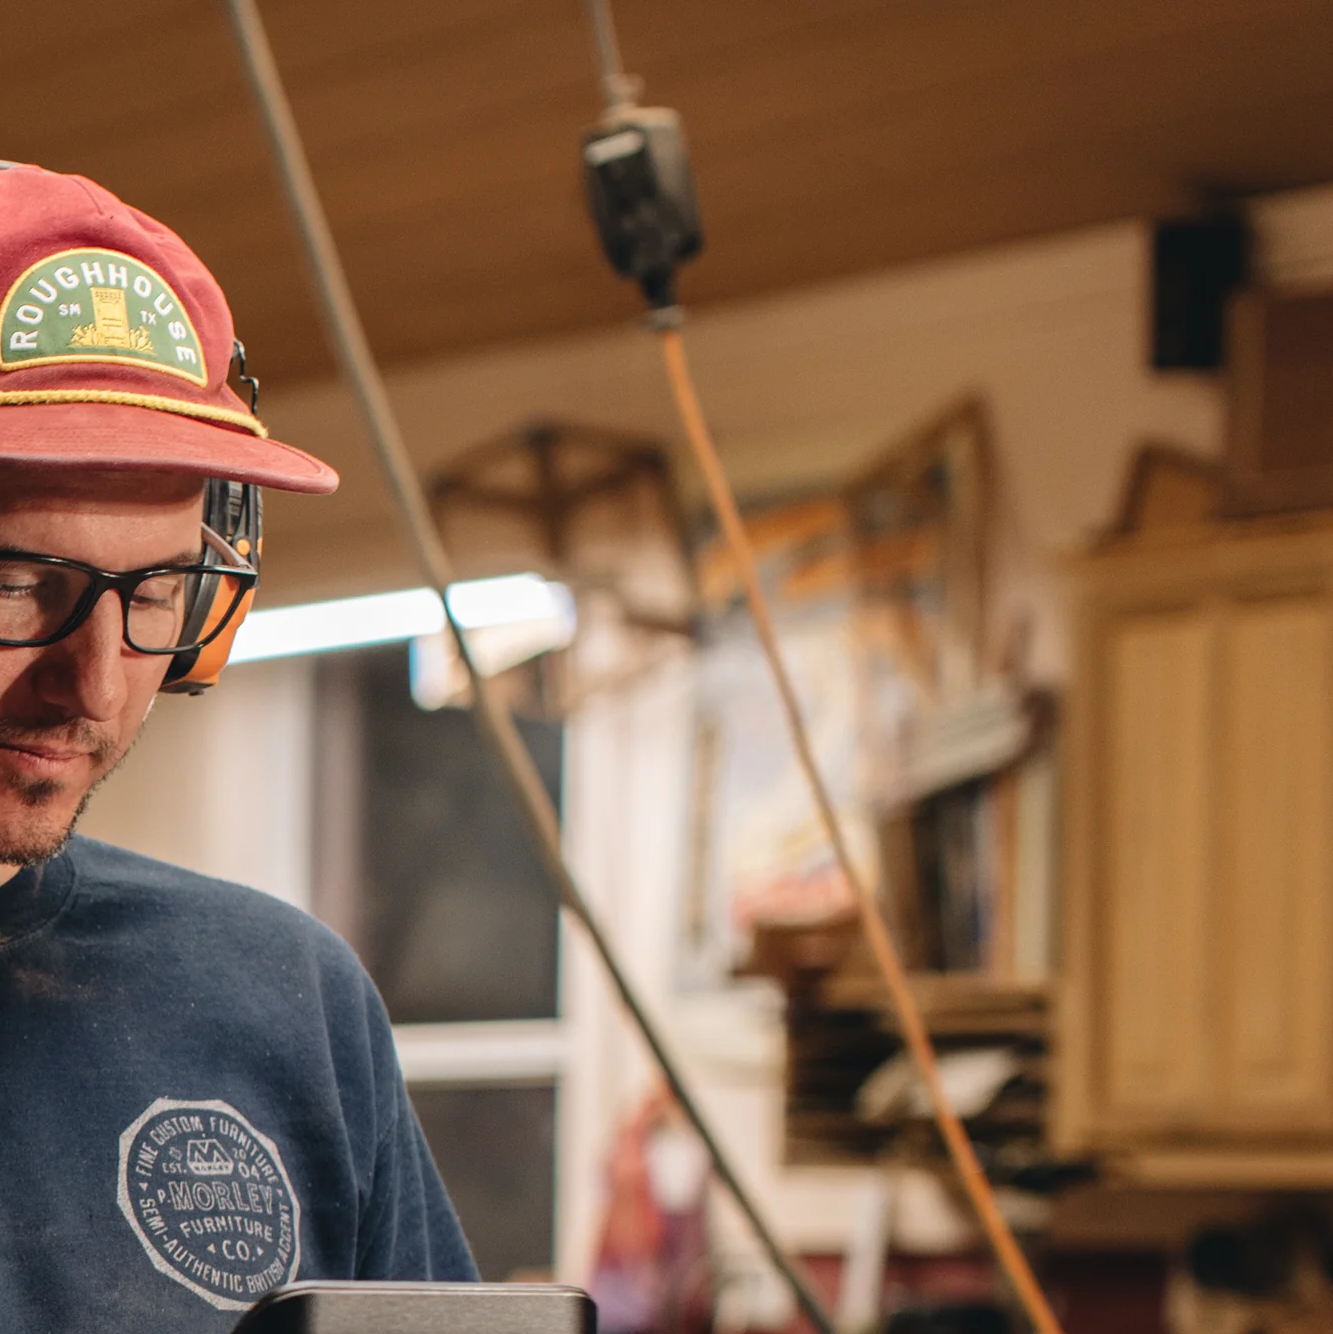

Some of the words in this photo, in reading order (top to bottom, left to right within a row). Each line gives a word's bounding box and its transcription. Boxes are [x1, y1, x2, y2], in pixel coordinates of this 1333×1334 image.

[10, 261, 197, 365] ROUGHHOUSE
[58, 303, 81, 317] SM
[140, 310, 157, 326] TX
[136, 1142, 159, 1177] FINE
[150, 1115, 204, 1146] CUSTOM
[209, 1116, 279, 1184] FURNITURE
[162, 1162, 187, 1174] EST.
[169, 1181, 273, 1215] MORLEY
[179, 1215, 274, 1243] FURNITURE
[139, 1198, 243, 1293] SEMI-AUTHENTIC
[245, 1257, 285, 1294] BRITISH
[222, 1239, 256, 1262] CO.
